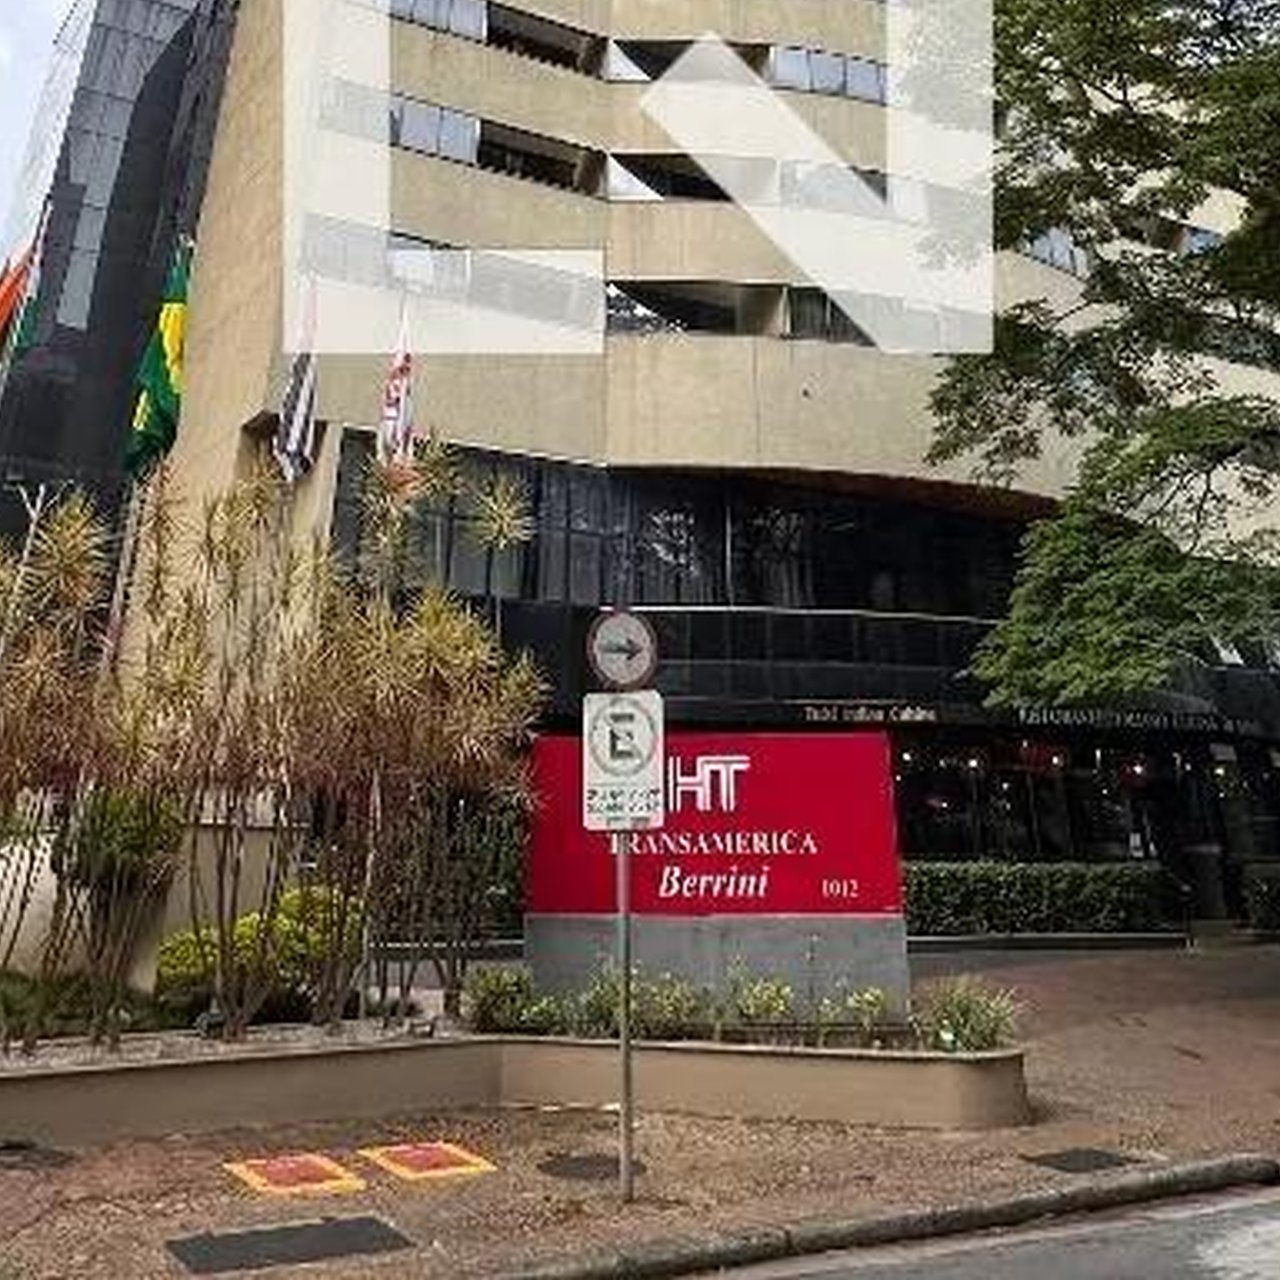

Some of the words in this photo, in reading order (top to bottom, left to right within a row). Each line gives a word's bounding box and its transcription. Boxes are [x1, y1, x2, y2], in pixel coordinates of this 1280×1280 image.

[608, 831, 819, 855] TRANSAMERICA
[658, 865, 771, 898] Berrini
[821, 878, 859, 898] 1012
